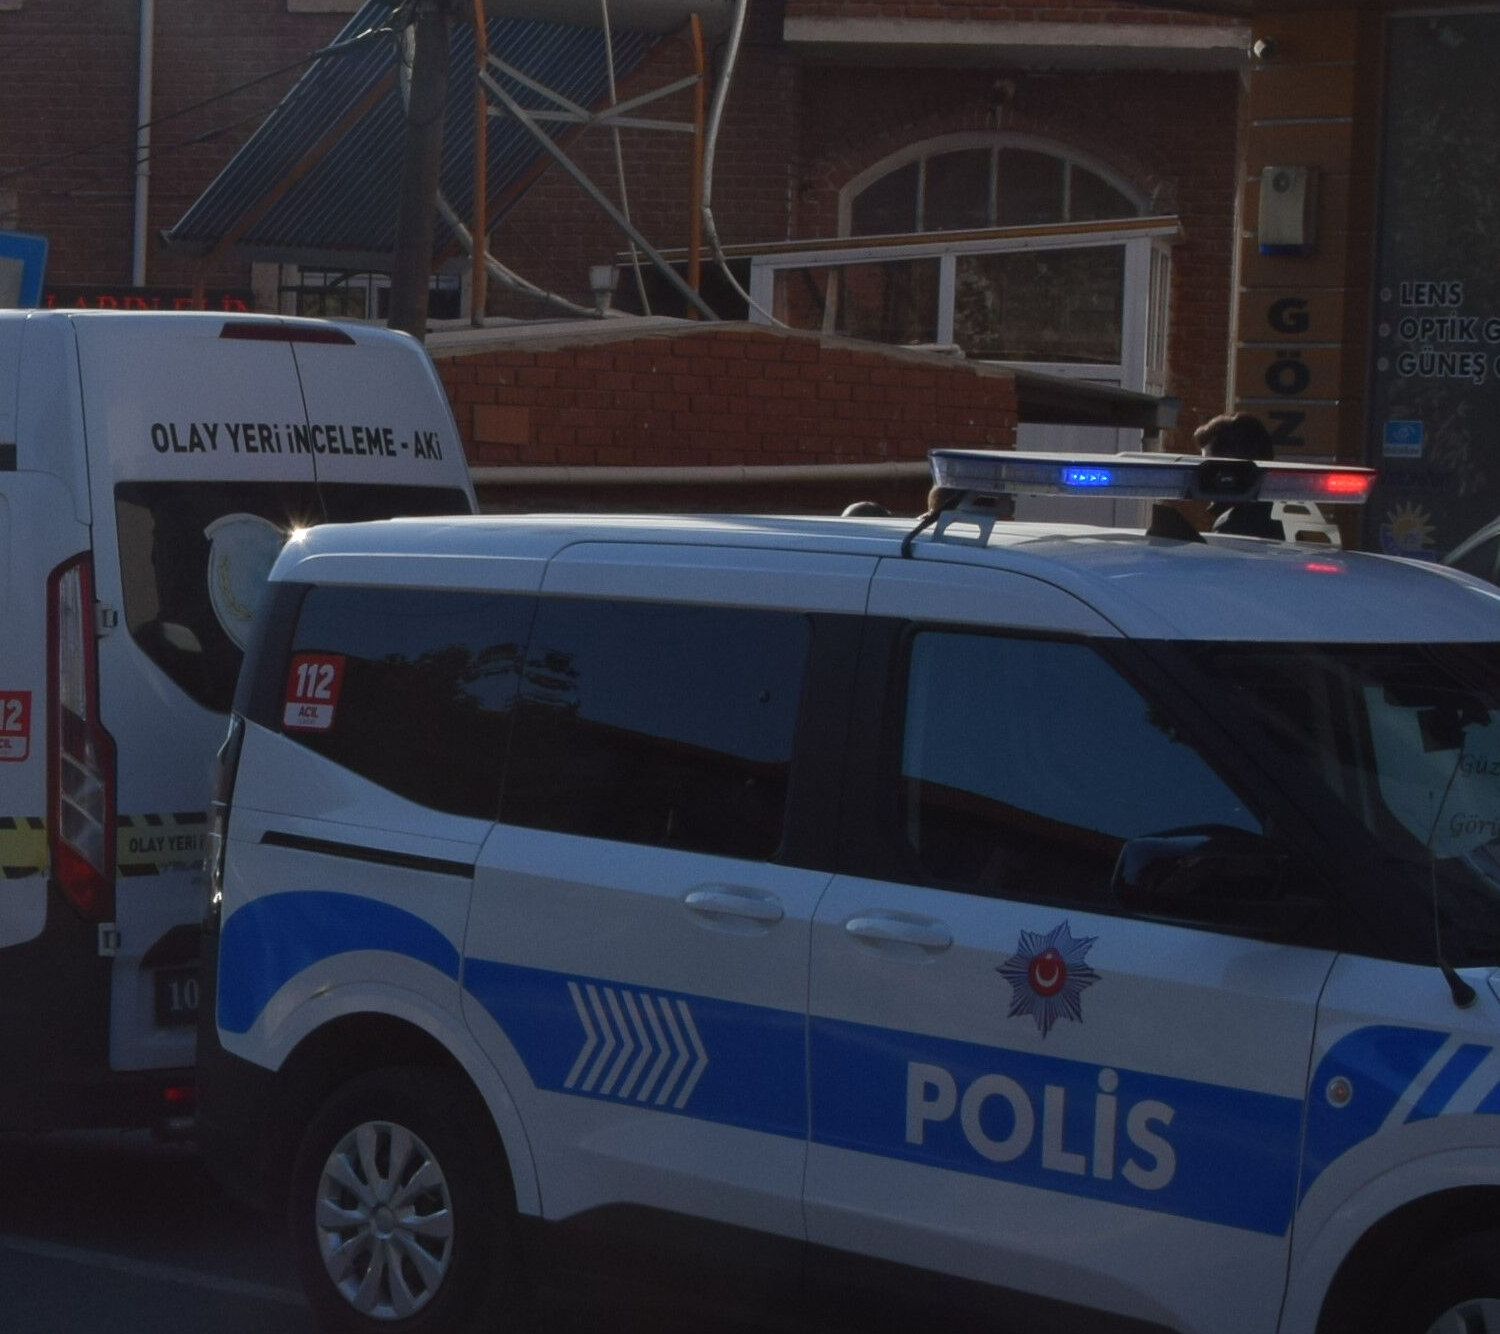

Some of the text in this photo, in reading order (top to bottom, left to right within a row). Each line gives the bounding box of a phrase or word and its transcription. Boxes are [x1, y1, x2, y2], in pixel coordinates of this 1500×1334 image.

[1400, 281, 1464, 307] LENS
[1398, 310, 1480, 345] OPTİK
[1397, 345, 1487, 386] GÜNEŞ
[151, 422, 219, 454] OLAY
[225, 423, 280, 453] YERİ
[296, 662, 335, 700] 112
[129, 837, 164, 854] OLAY
[168, 978, 200, 1012] 10
[903, 1061, 1177, 1193] POLİS
